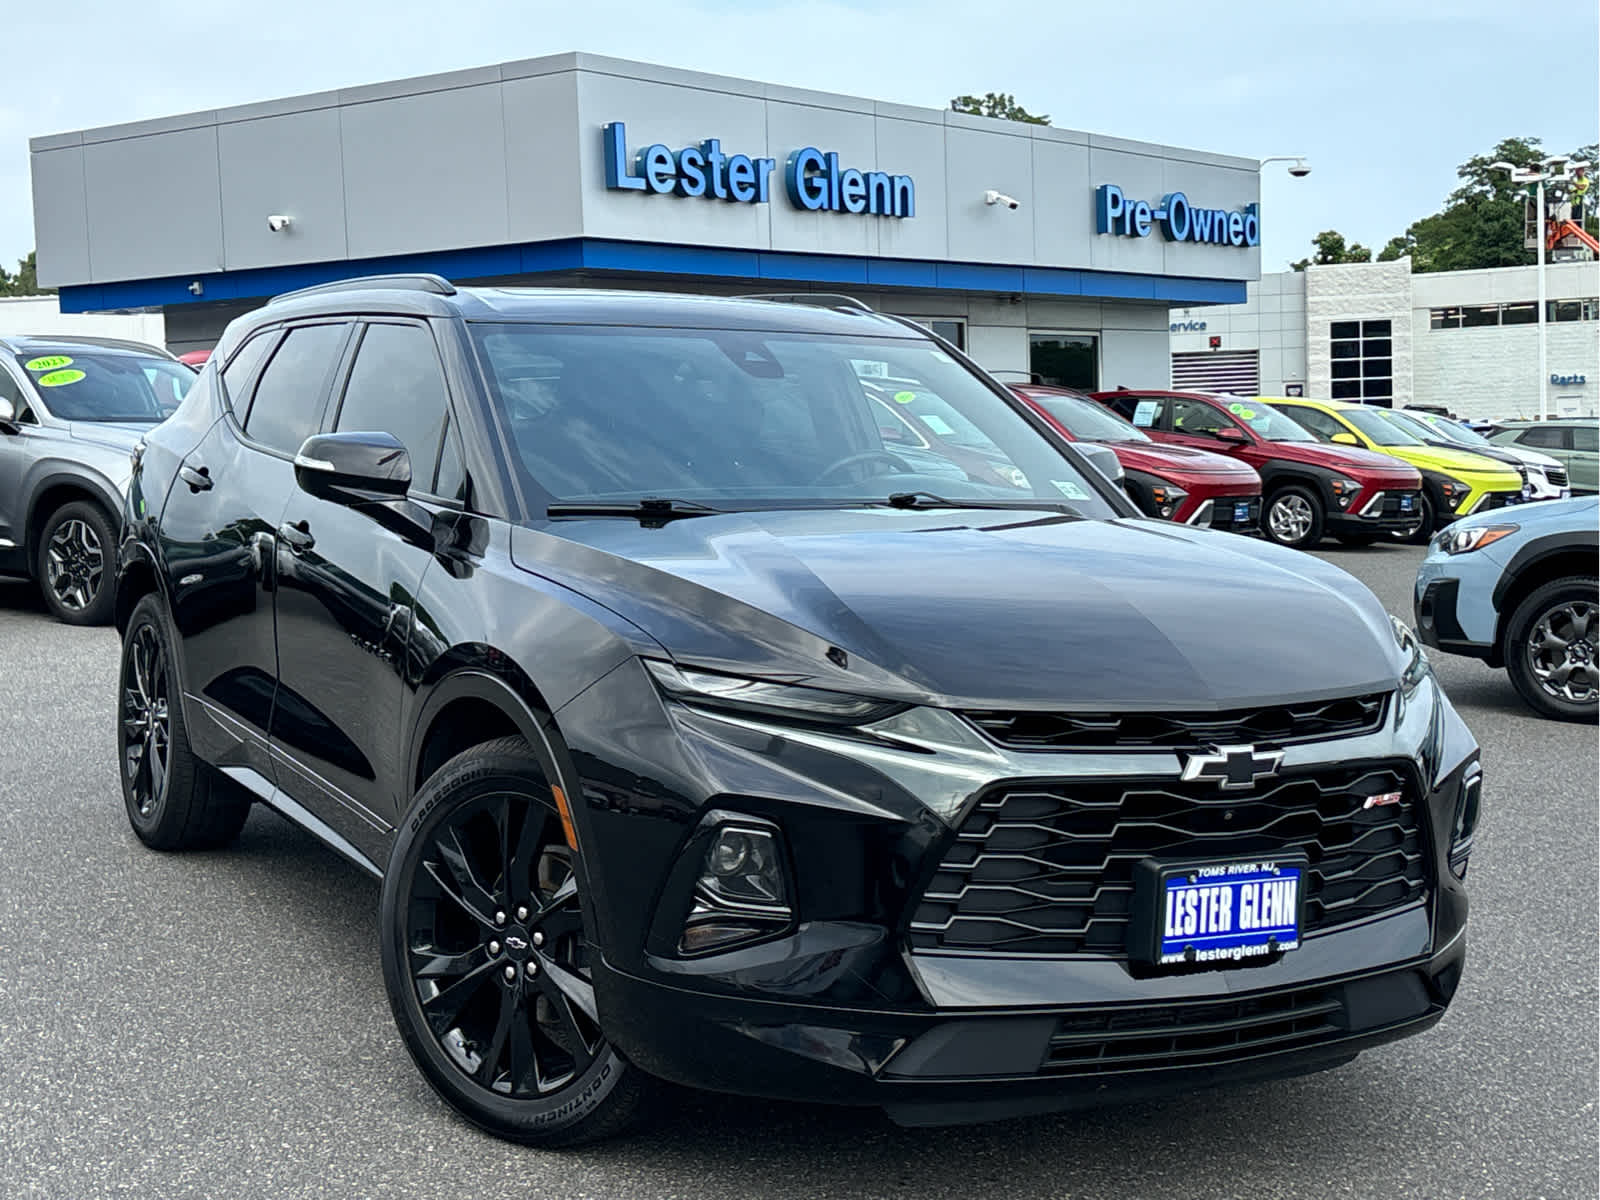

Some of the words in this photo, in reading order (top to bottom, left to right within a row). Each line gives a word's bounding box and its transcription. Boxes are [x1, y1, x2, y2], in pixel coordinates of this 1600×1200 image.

[602, 121, 775, 203] Lester
[785, 146, 916, 217] Glenn
[1096, 184, 1261, 247] Pre-Owned
[1169, 319, 1207, 333] ervice
[1550, 373, 1586, 385] Parts
[1198, 866, 1225, 878] TOMS
[1260, 862, 1275, 873] NJ
[1164, 885, 1233, 938] LESTER
[1239, 880, 1297, 930] GLENN
